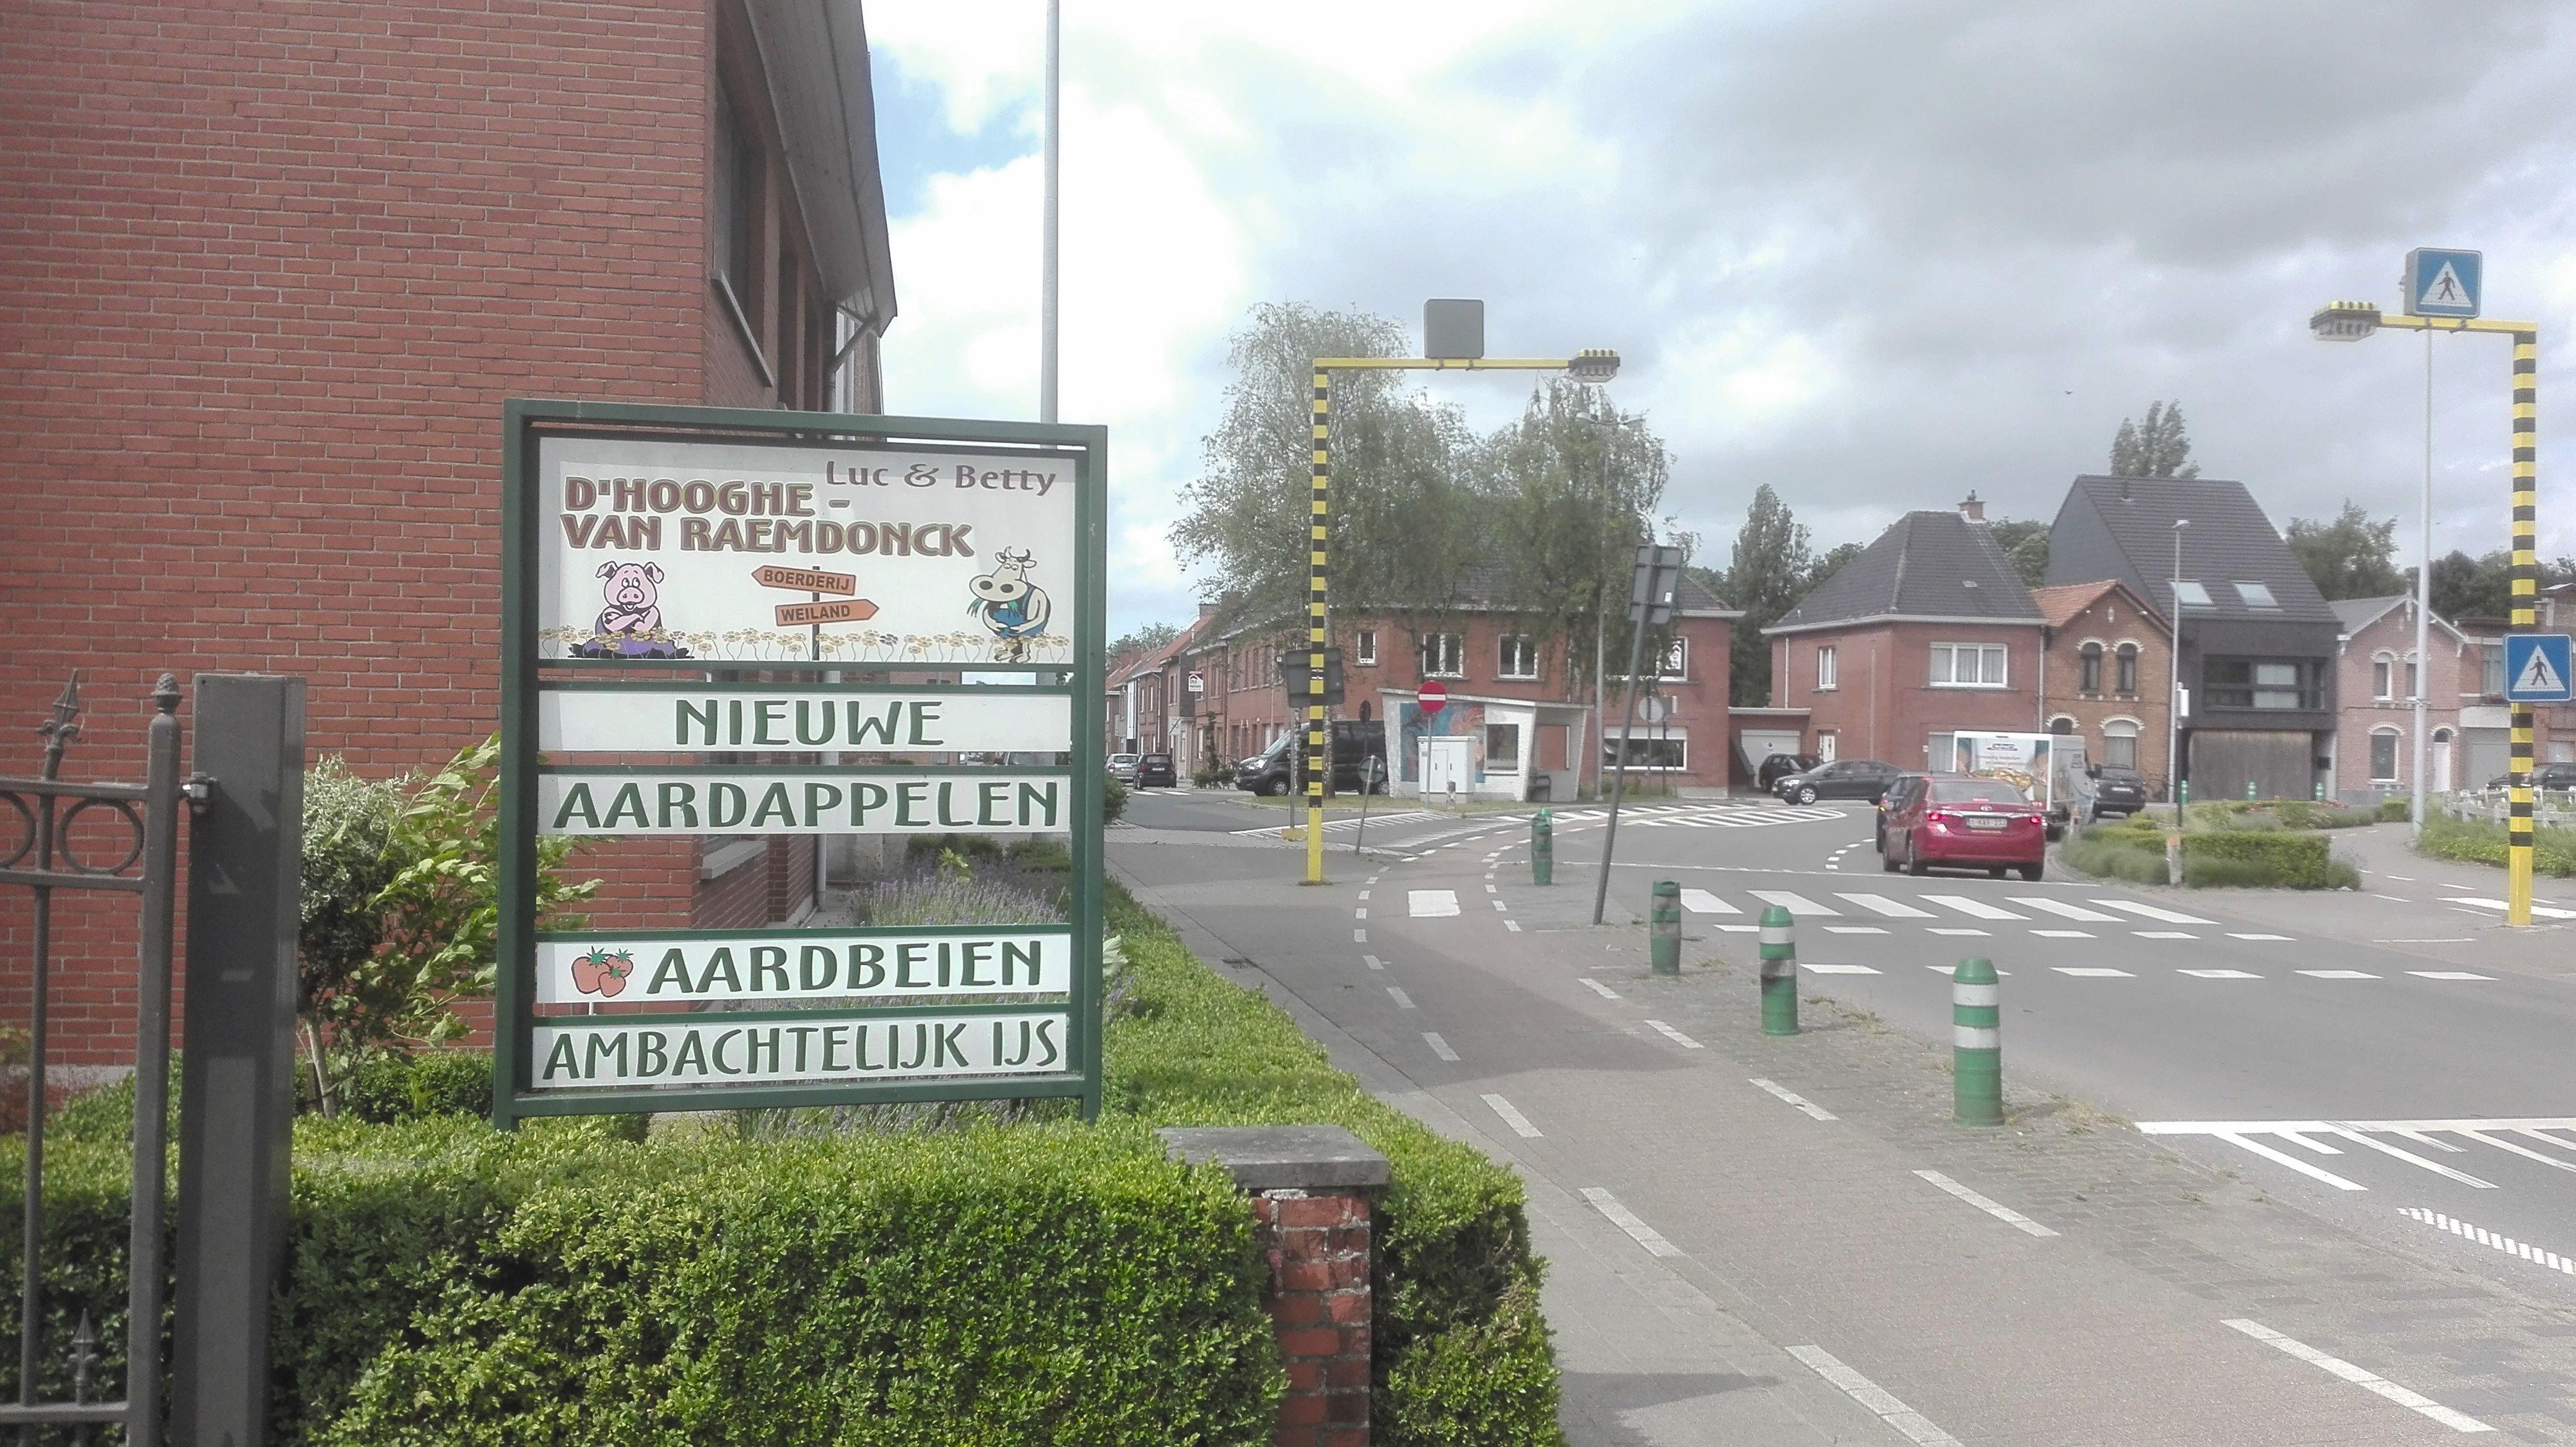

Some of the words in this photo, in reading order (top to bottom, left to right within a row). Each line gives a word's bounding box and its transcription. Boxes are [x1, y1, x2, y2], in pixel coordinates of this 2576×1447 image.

[564, 476, 814, 517] D'HOOGHE
[825, 460, 888, 487] Luc
[903, 462, 940, 488] &
[954, 463, 1056, 496] Betty
[560, 514, 662, 551] VAN
[680, 516, 975, 557] RAEMDONCK
[762, 569, 850, 592] BOERDERIJ
[781, 603, 850, 622] WEILAND
[676, 699, 944, 746] NIEUWE
[552, 780, 1058, 829] AARDAPPELEN
[646, 940, 1042, 994] AARDBEIEN
[542, 1022, 968, 1080] AMBACHTELIJK
[991, 1018, 1058, 1067] IJS
